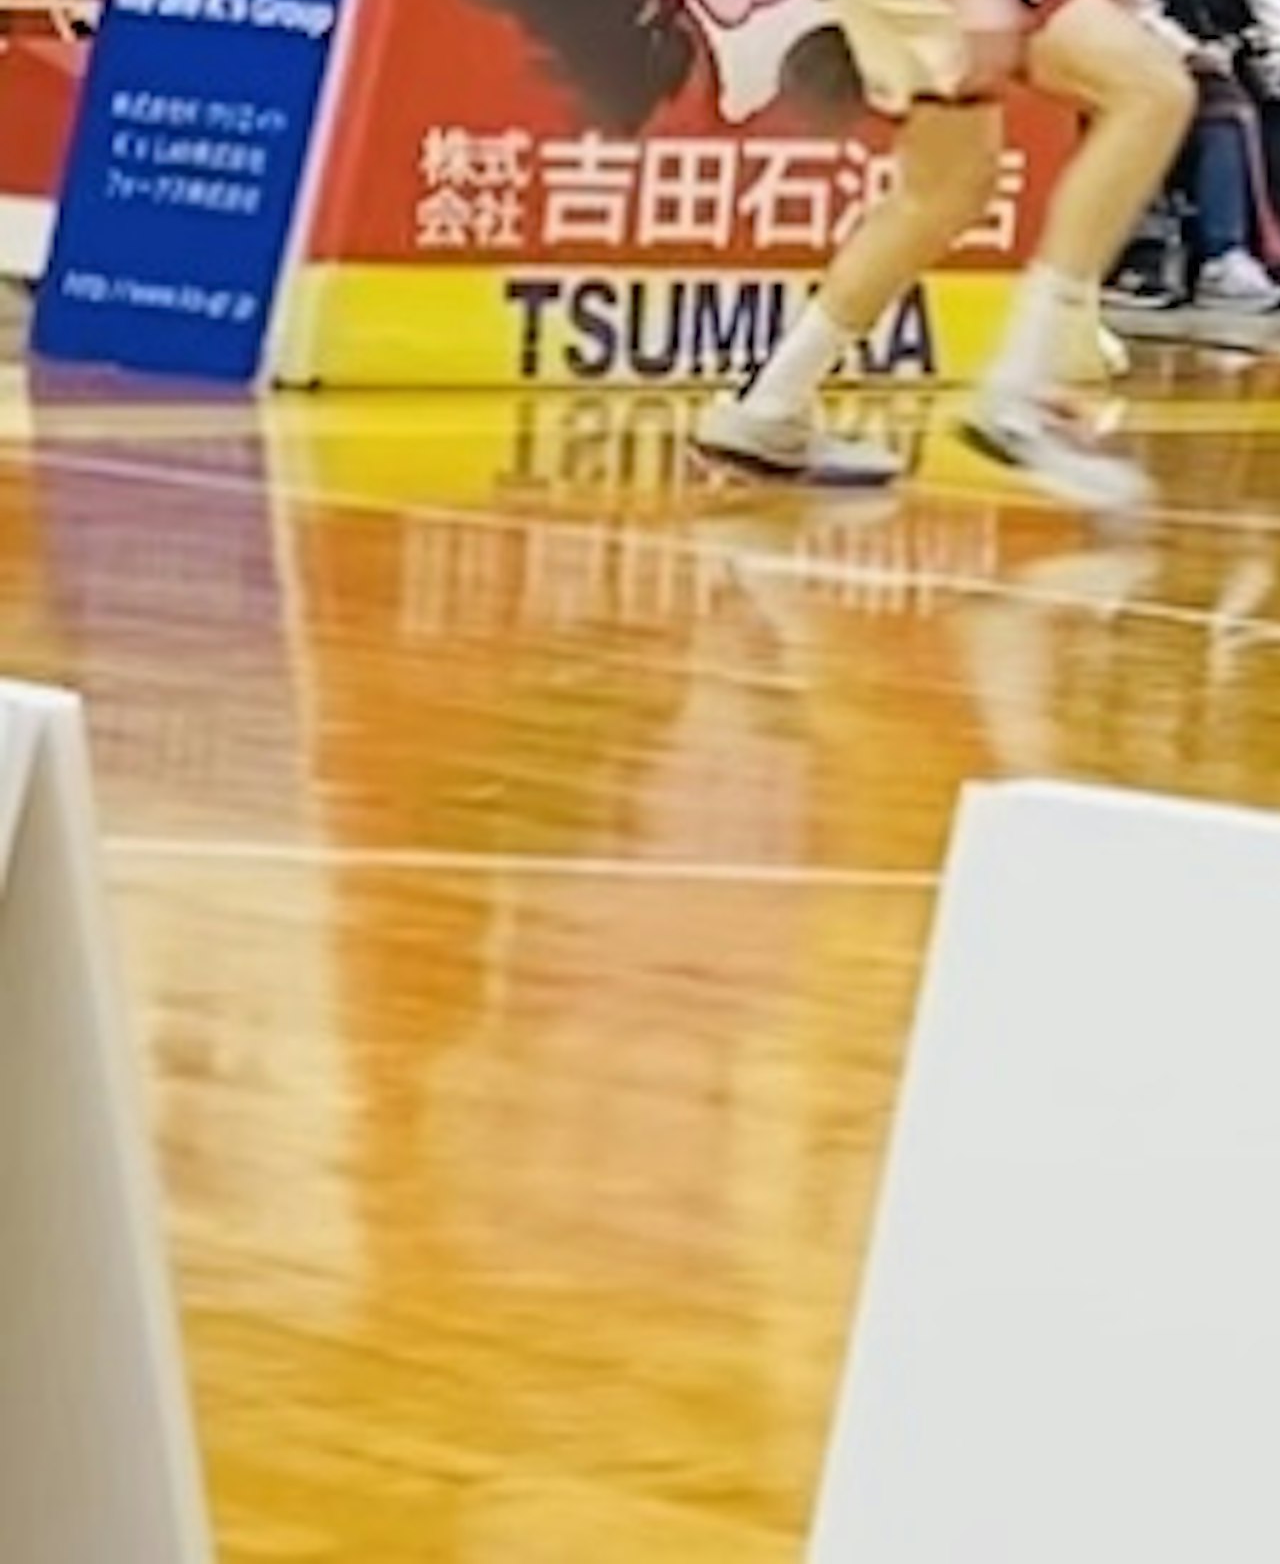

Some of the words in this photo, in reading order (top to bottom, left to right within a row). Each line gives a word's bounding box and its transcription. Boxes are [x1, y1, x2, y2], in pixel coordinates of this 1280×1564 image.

[418, 125, 531, 190] 株式
[415, 187, 526, 249] 会社
[504, 279, 938, 379] TSUMA
